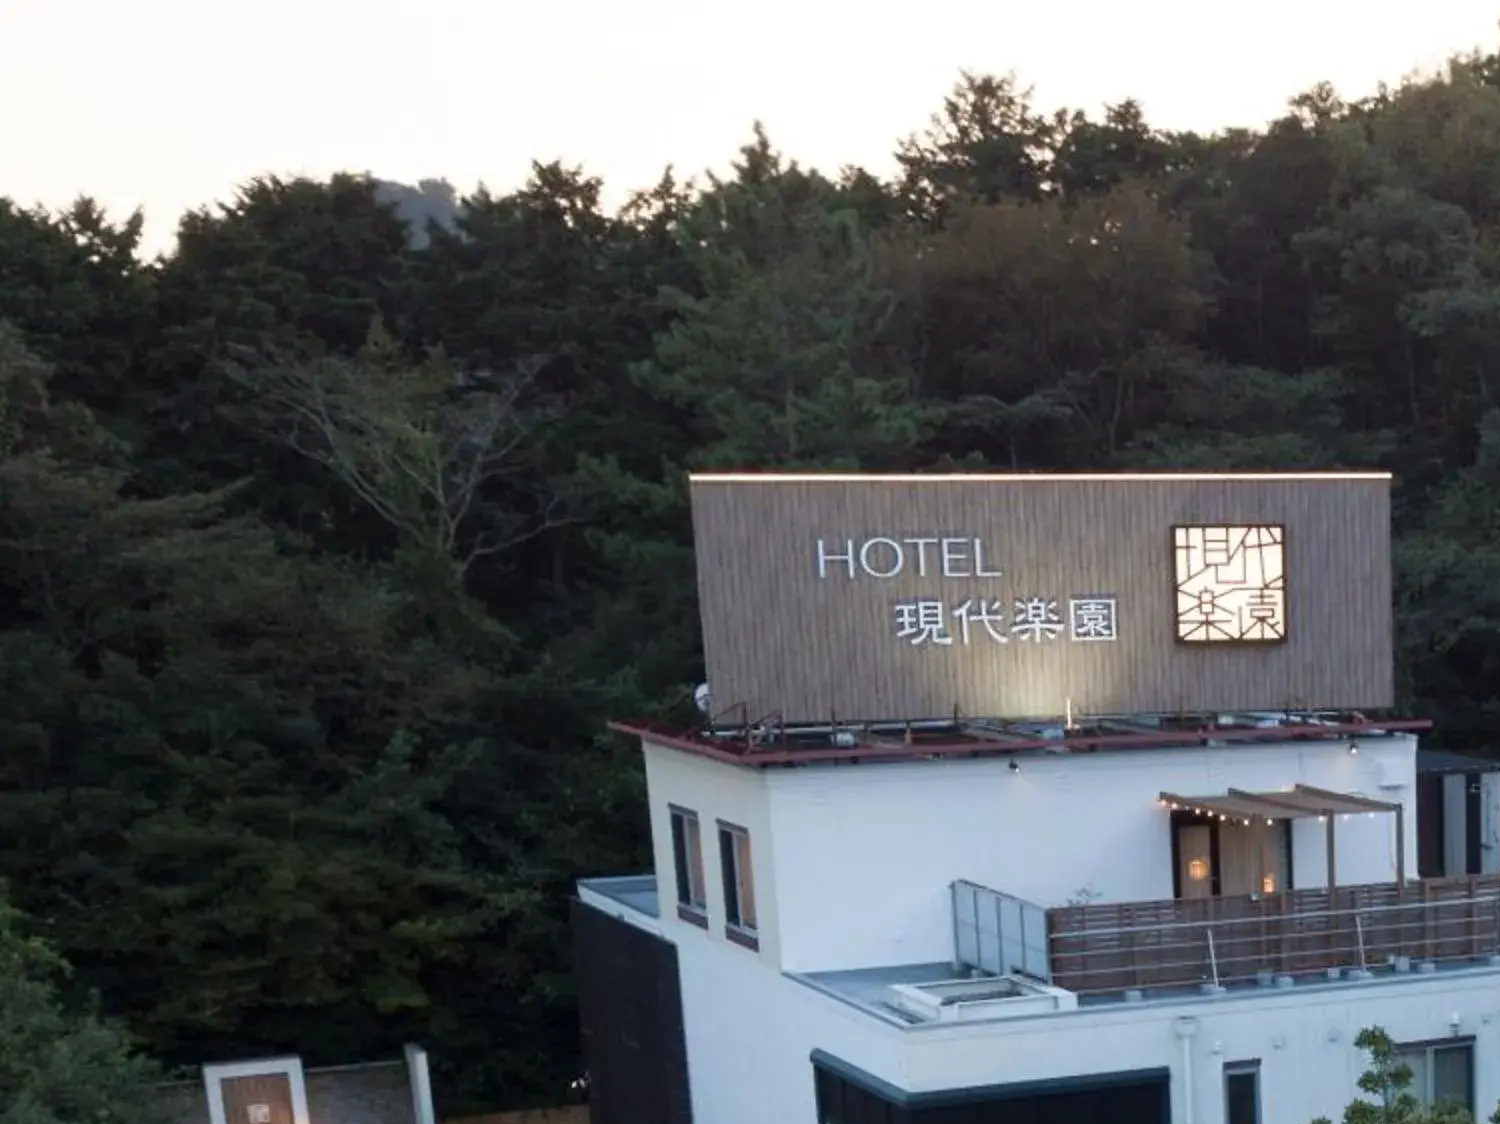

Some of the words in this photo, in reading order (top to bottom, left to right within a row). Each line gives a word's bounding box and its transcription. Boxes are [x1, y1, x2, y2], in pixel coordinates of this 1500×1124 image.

[817, 537, 1002, 579] HOTEL
[895, 598, 1117, 645] 現代楽園
